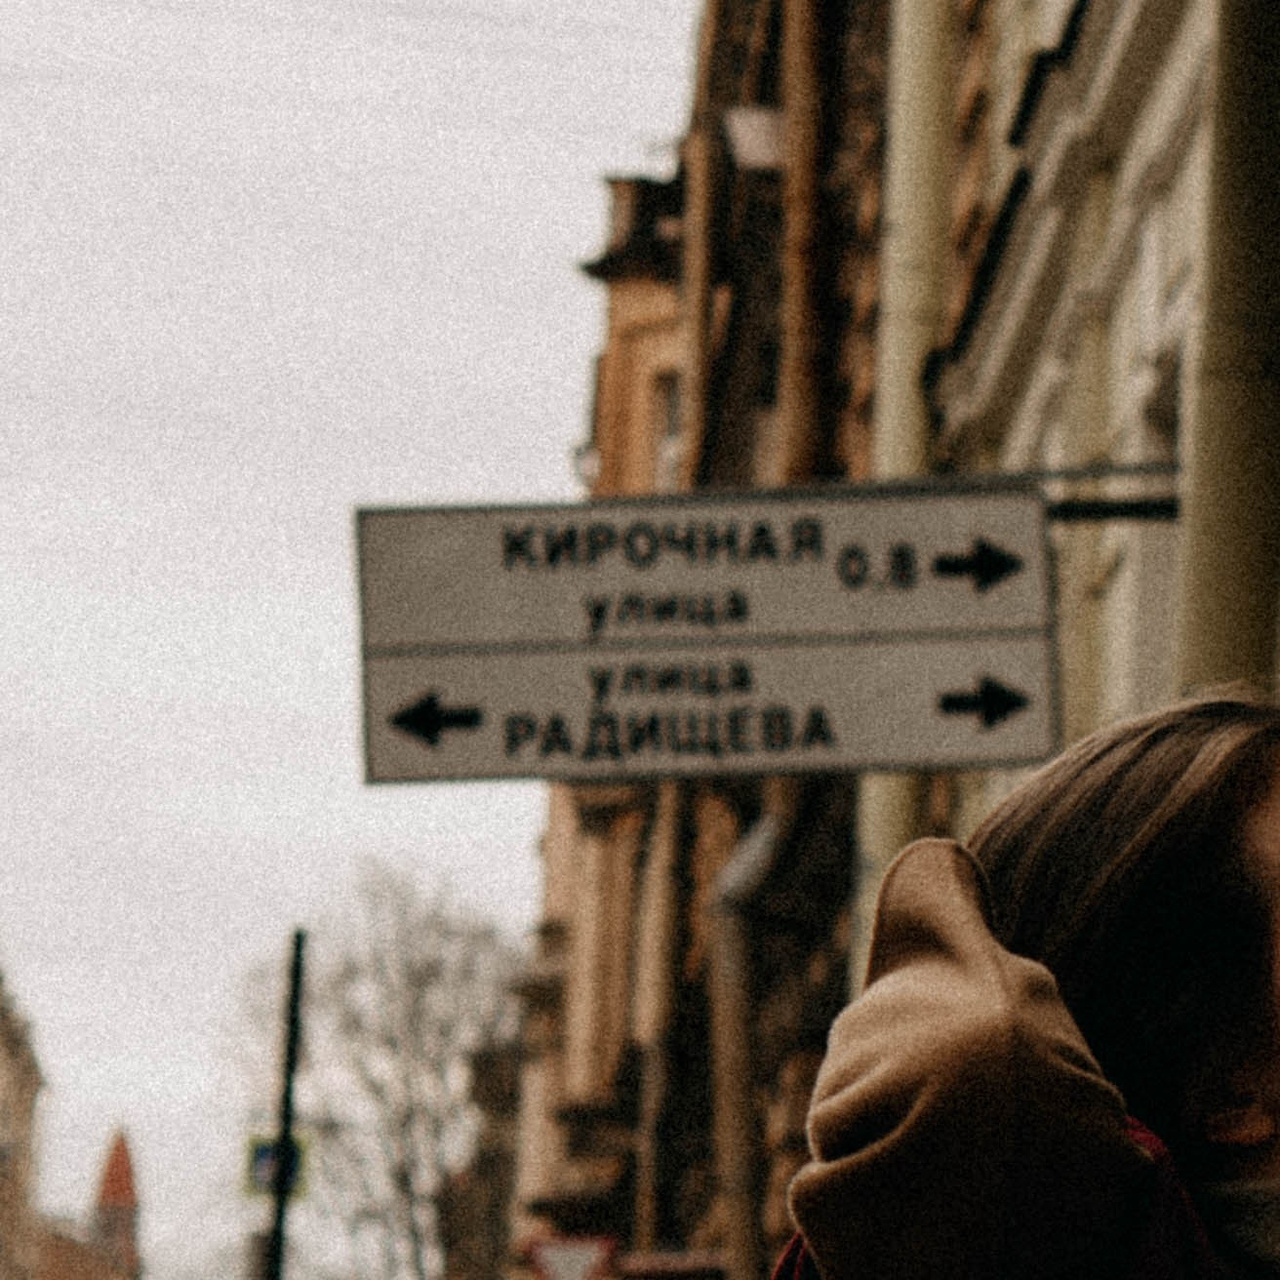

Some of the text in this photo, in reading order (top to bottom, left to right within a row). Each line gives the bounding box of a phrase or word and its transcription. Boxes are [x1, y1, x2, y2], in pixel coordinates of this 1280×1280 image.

[504, 517, 824, 570] КИРОЧНАЯ
[586, 590, 749, 638] улица
[589, 662, 752, 706] улица
[505, 706, 835, 761] РАДИЩЕВА
